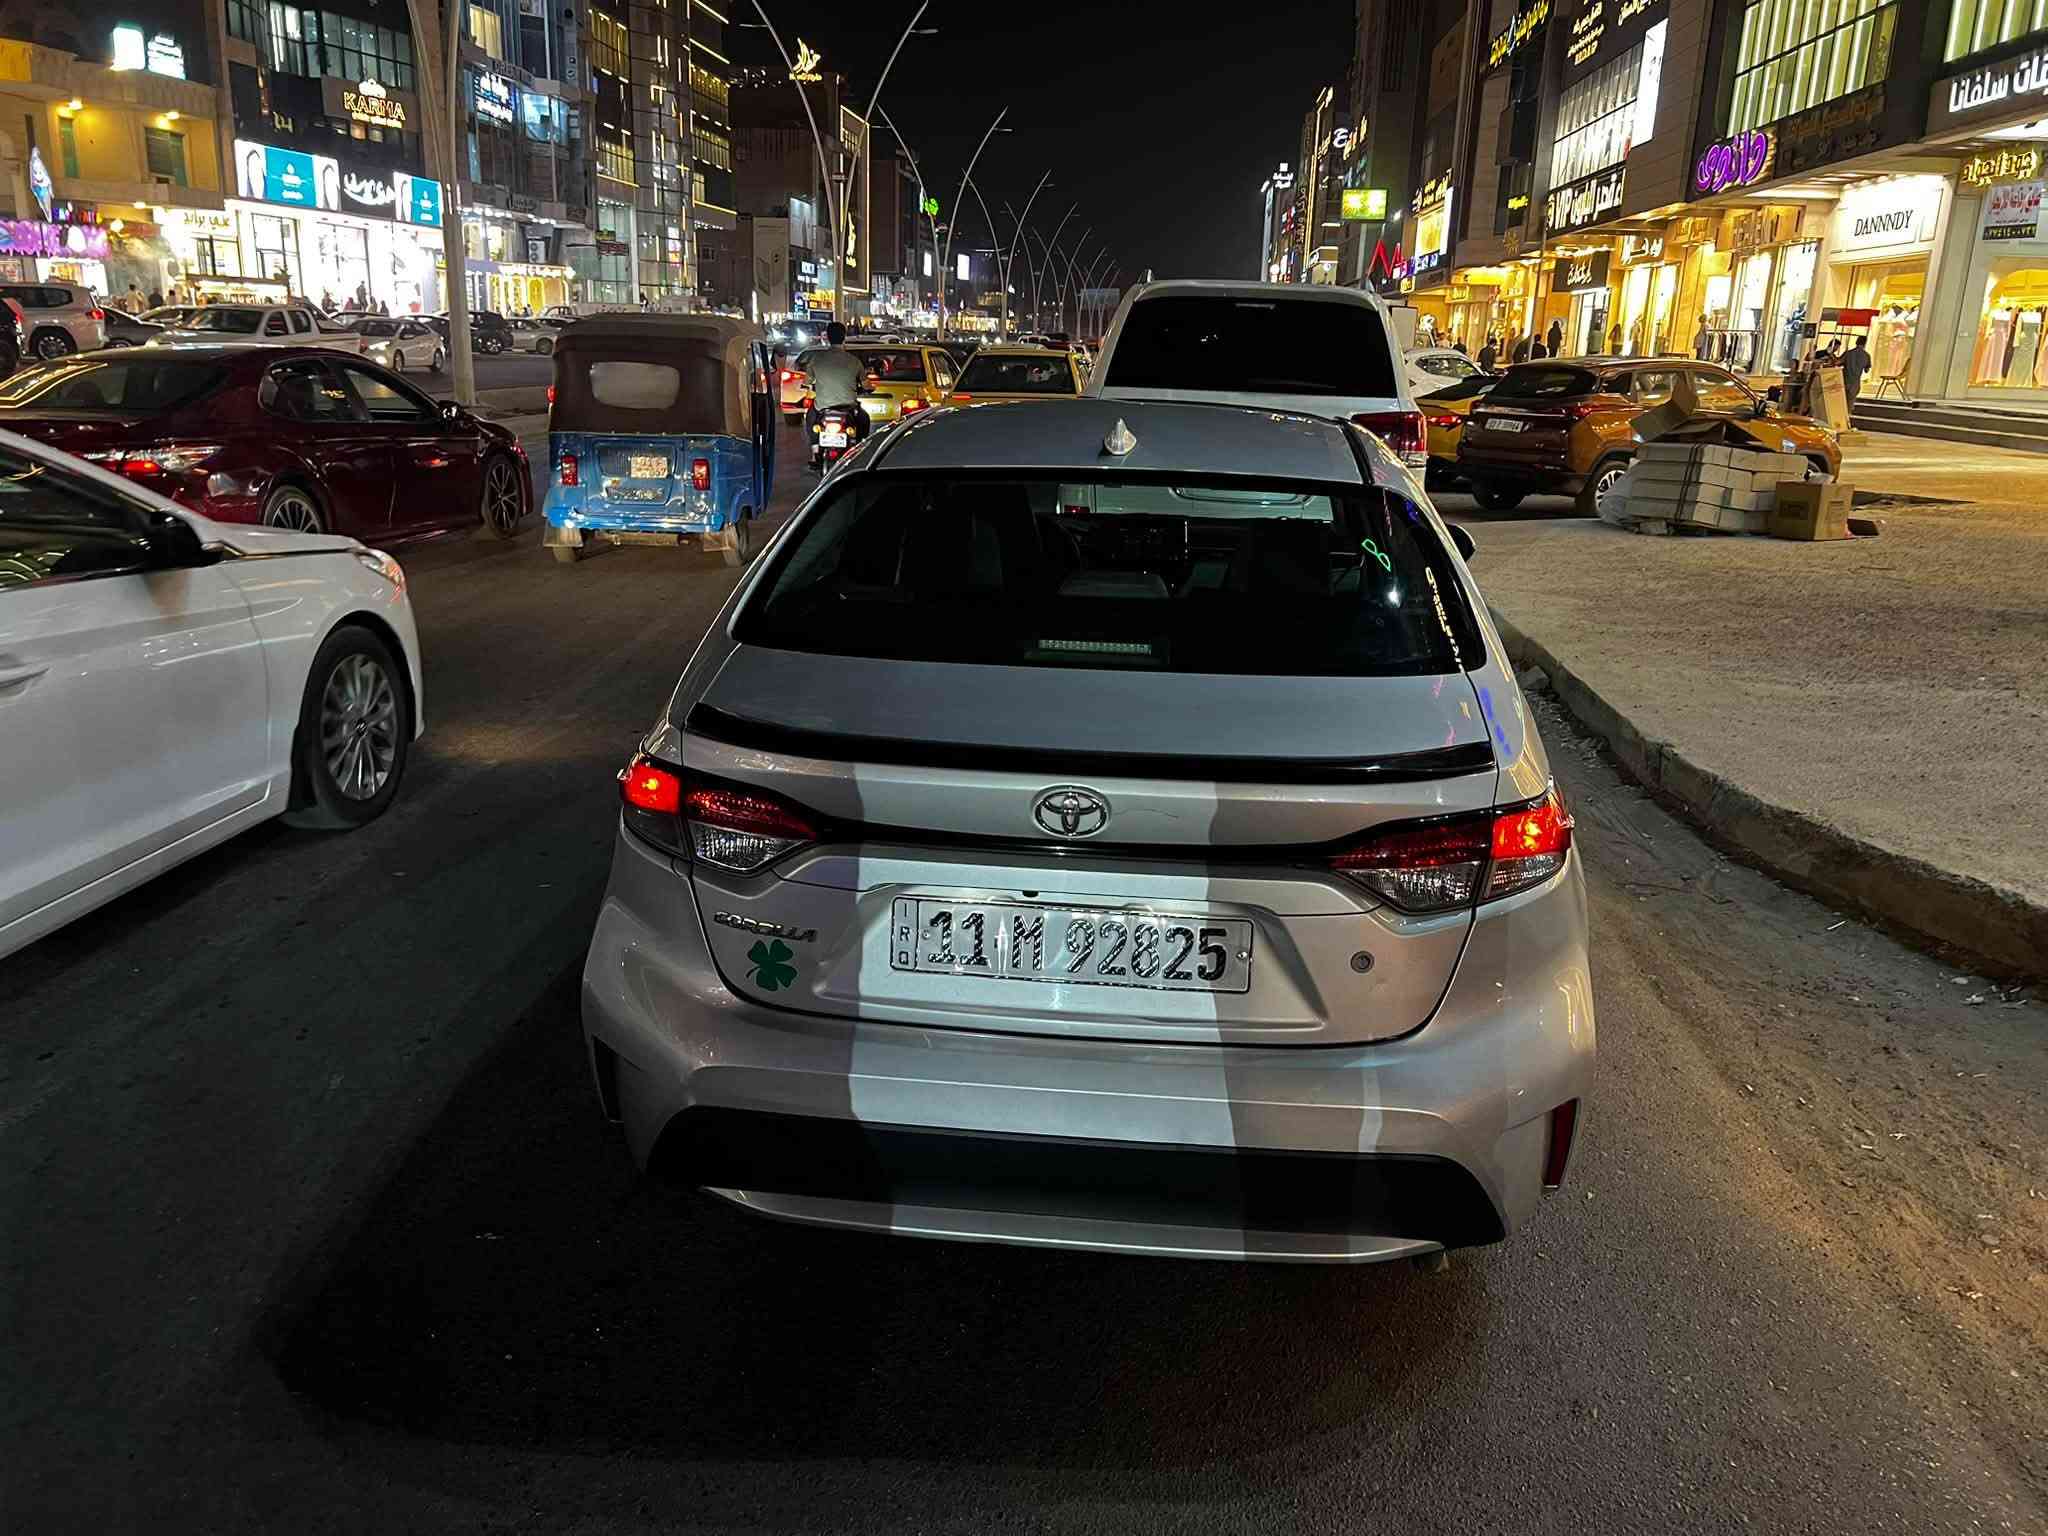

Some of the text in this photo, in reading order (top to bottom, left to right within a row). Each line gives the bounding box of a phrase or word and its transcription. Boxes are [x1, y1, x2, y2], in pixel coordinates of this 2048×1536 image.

[343, 91, 406, 121] KARMA
[1854, 209, 1914, 237] DANNNDY
[927, 910, 1228, 981] 11 M 92825
